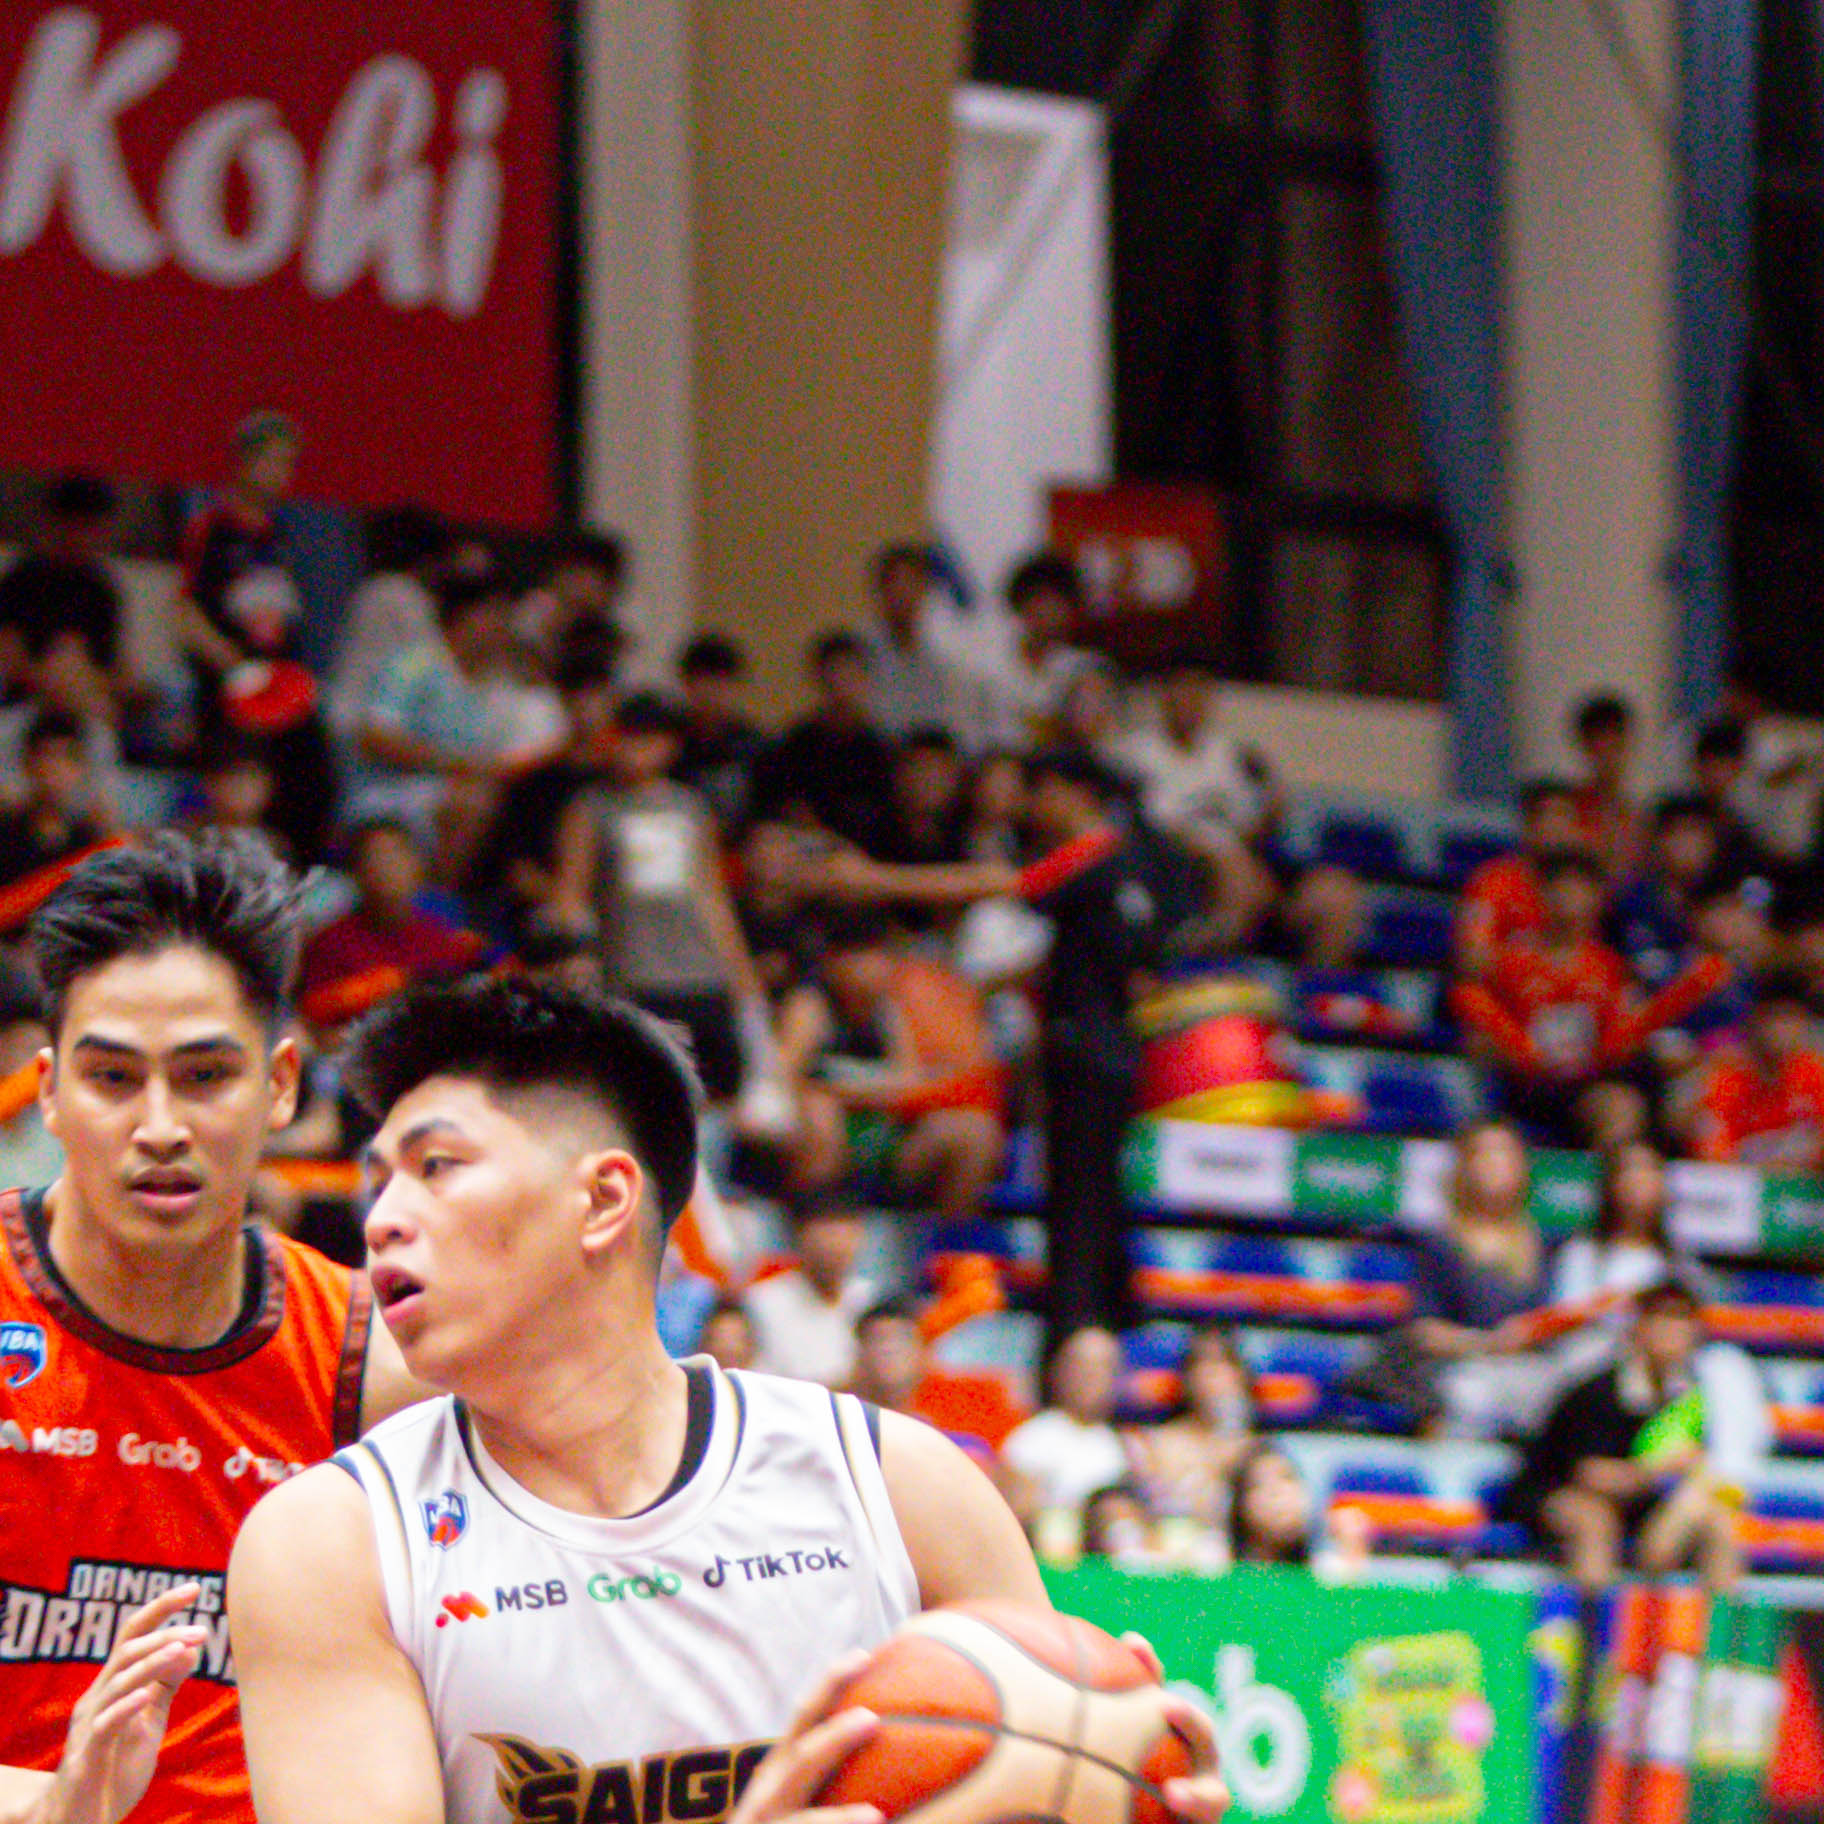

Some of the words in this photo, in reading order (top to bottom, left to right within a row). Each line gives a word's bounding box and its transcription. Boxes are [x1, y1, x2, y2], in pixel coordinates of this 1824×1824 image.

[33, 1427, 98, 1456] MSB
[117, 1432, 202, 1473] Grab
[495, 1578, 569, 1614] MSB
[586, 1563, 682, 1605] Grab
[736, 1545, 849, 1584] TikTok
